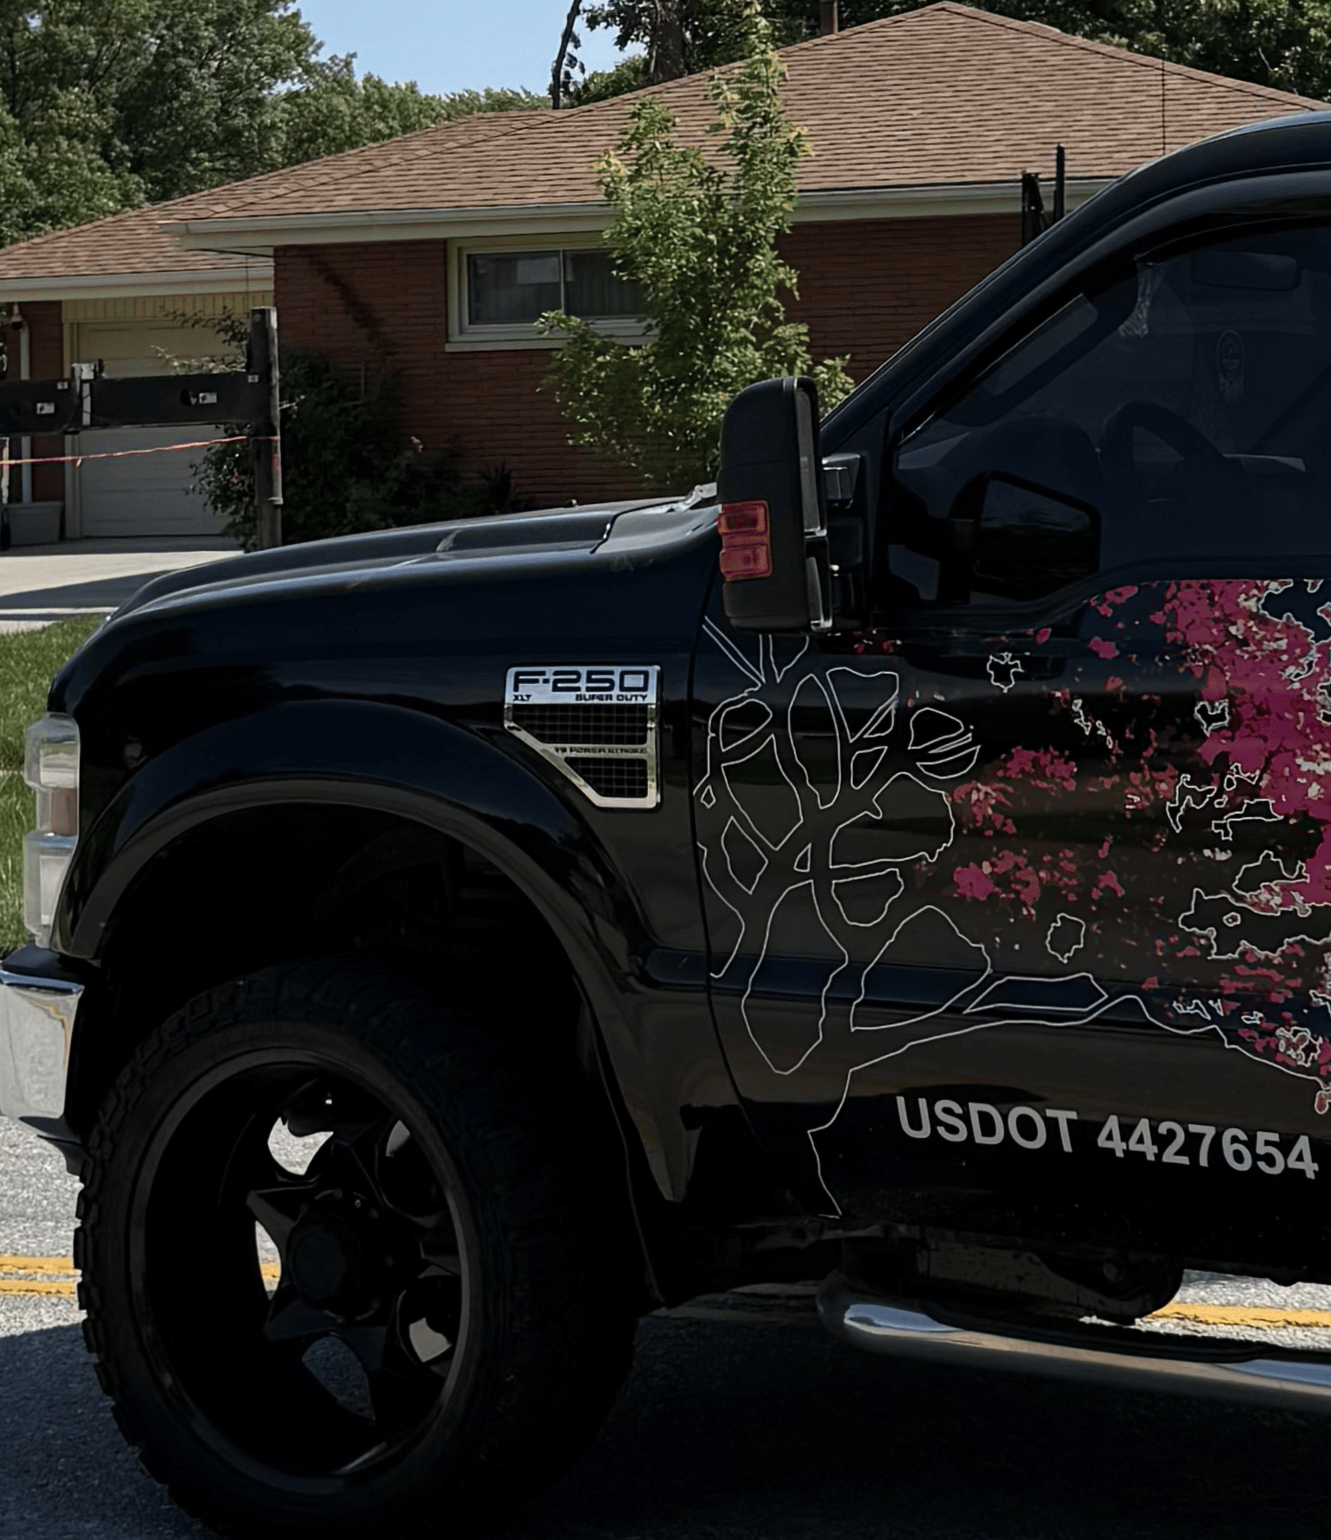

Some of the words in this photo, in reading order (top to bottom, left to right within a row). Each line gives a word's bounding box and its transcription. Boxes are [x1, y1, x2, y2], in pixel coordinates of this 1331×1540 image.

[513, 669, 650, 693] F-250
[616, 693, 648, 702] DUTY
[895, 1096, 1079, 1153] USDOT
[1096, 1114, 1320, 1180] 4427654
